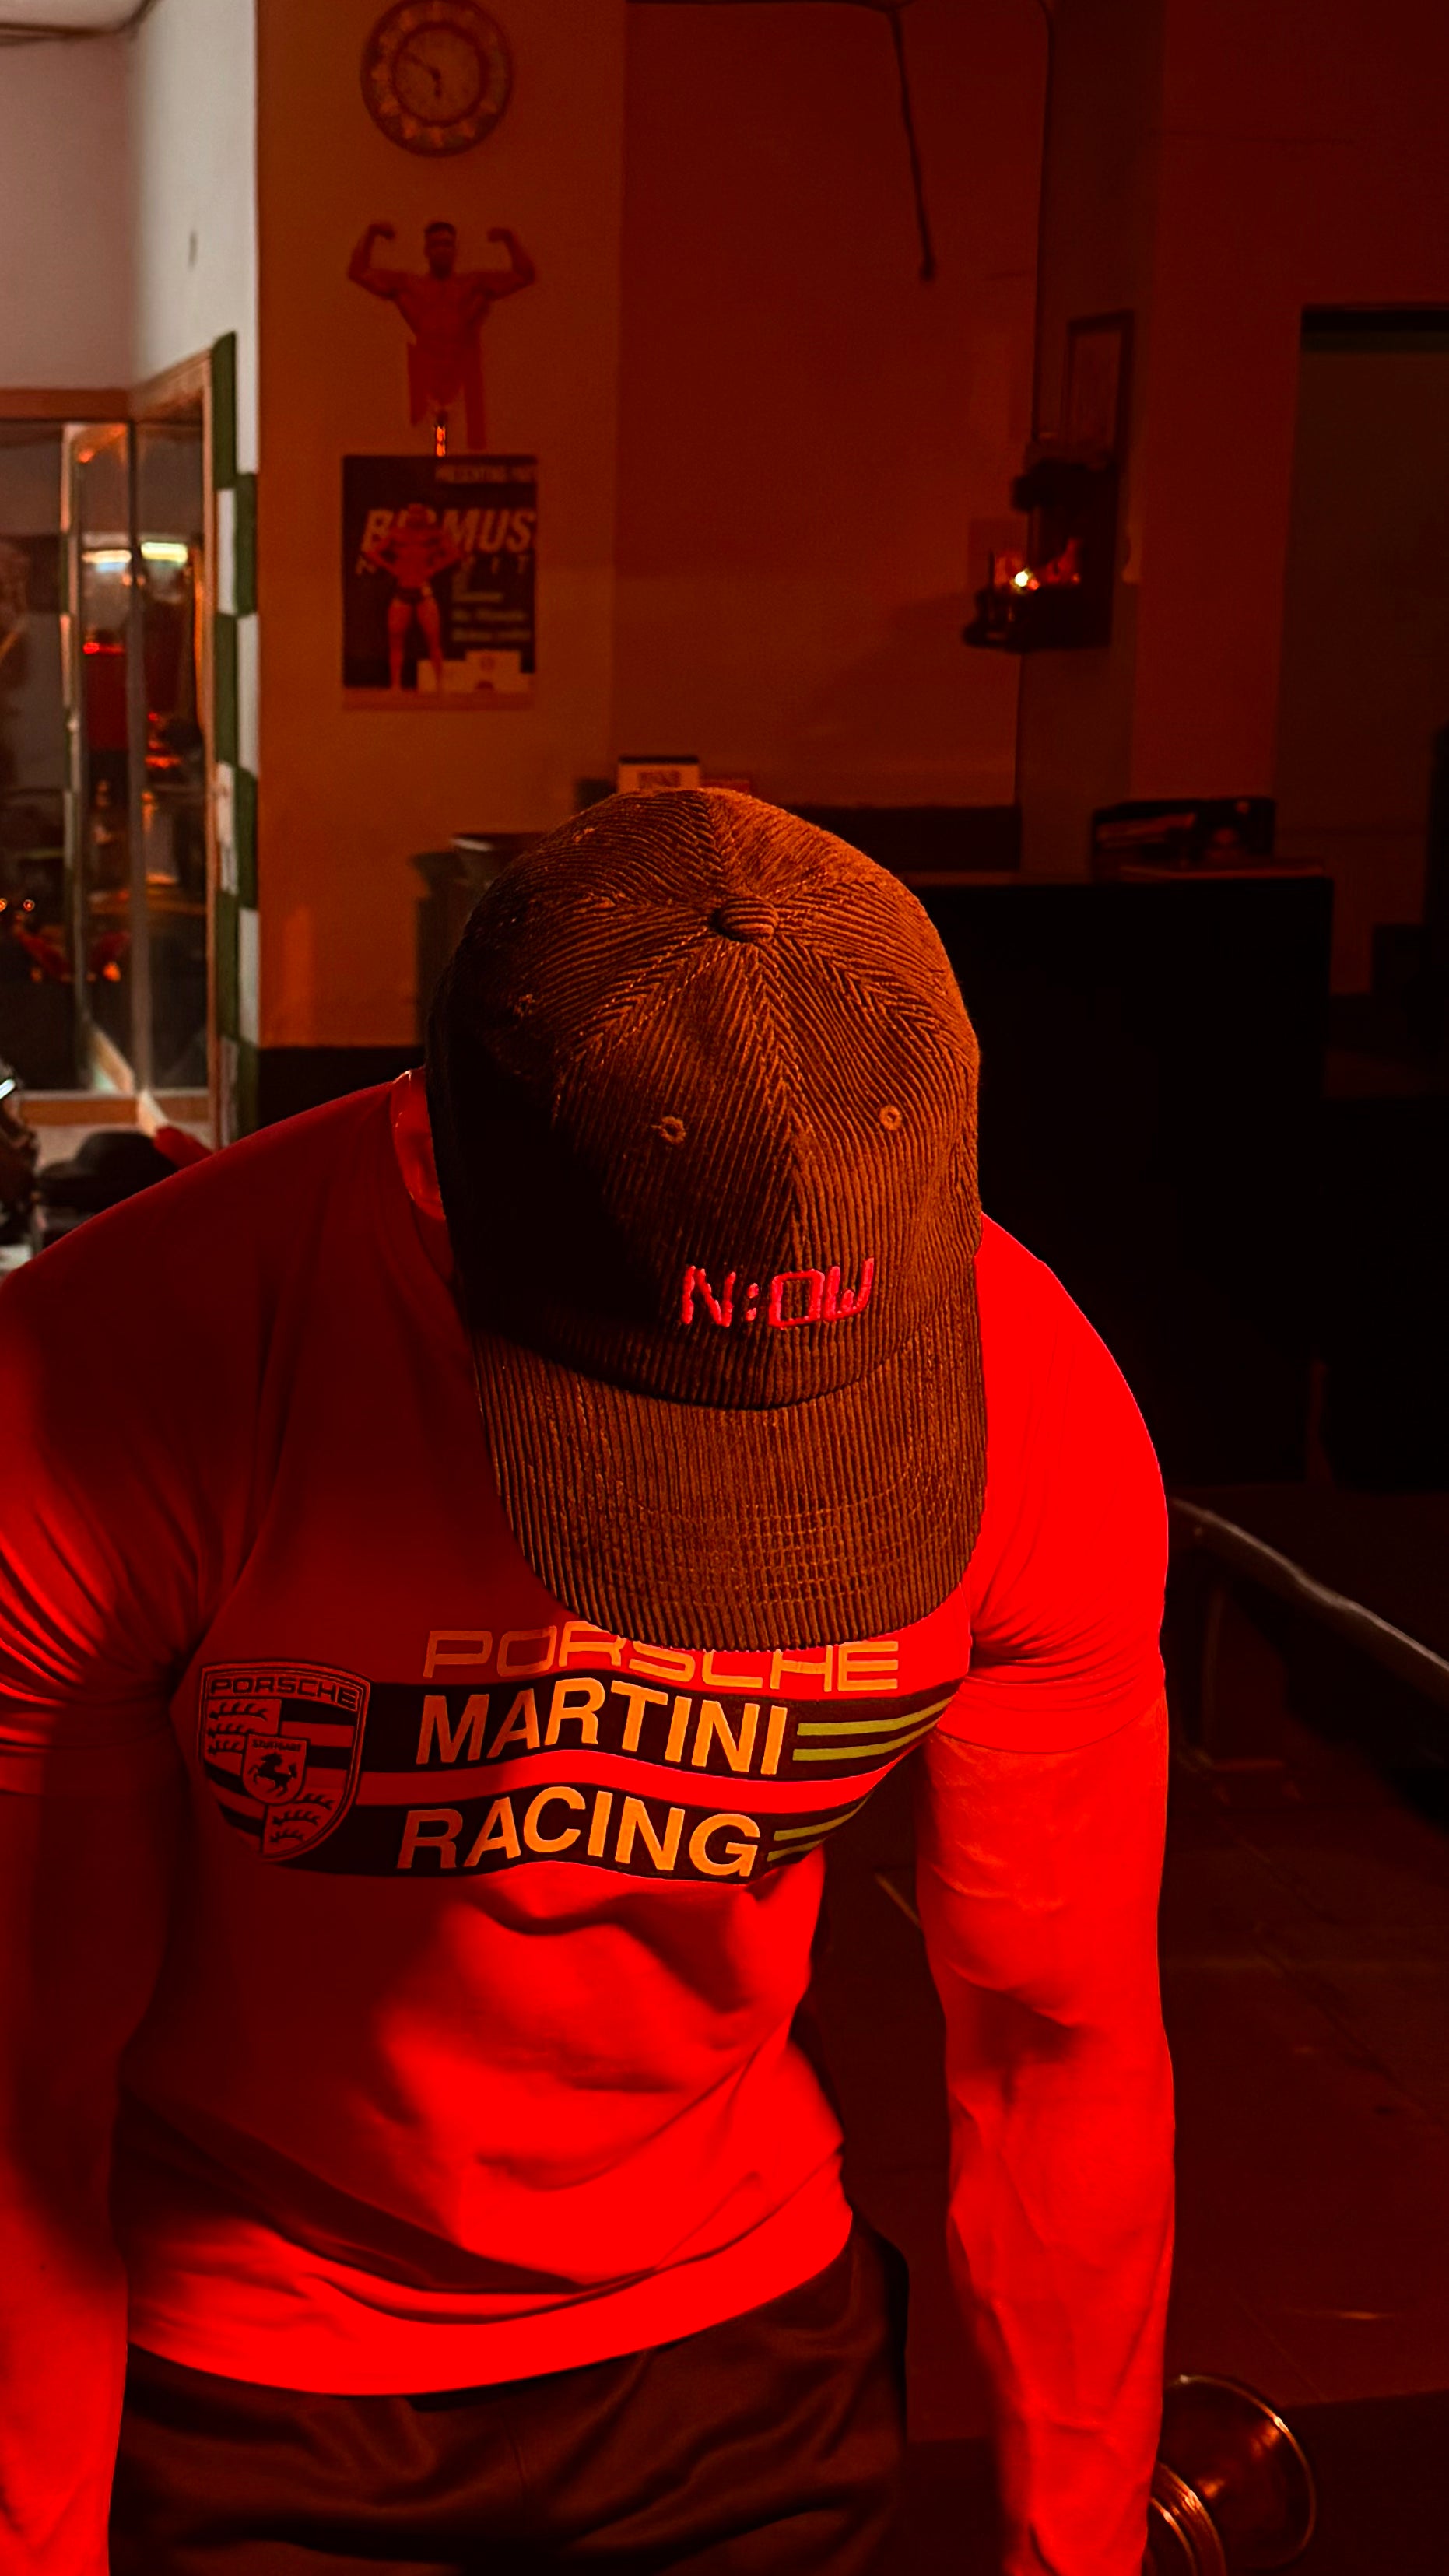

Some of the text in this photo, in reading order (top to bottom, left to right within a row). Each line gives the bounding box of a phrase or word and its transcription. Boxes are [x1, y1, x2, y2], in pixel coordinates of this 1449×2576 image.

[681, 1257, 874, 1328] N:OW
[423, 1621, 898, 1691] PORSCHE
[211, 1677, 356, 1709] PORSCHE
[416, 1677, 787, 1775] MARTINI
[397, 1786, 760, 1877] RACING
